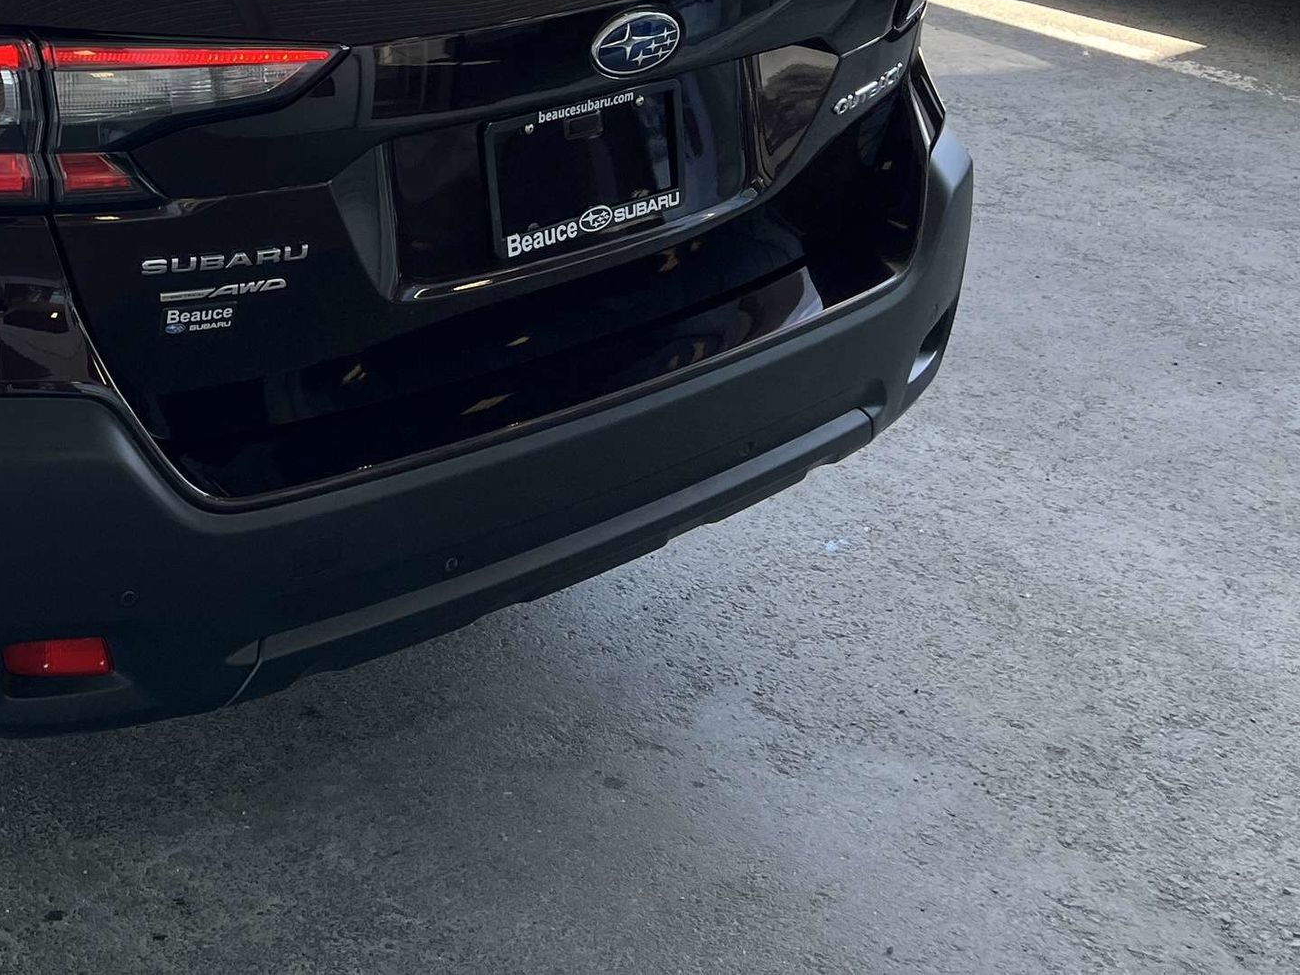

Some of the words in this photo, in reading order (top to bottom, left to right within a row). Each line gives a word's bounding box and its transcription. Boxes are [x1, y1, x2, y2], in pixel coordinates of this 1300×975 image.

[538, 91, 634, 123] beaucesubaru.com
[506, 220, 578, 258] Beauce
[613, 191, 680, 223] SUBARU
[141, 243, 309, 275] SUBARU
[208, 278, 288, 299] AWD
[166, 307, 233, 324] Beauce
[189, 320, 231, 331] SUBARU
